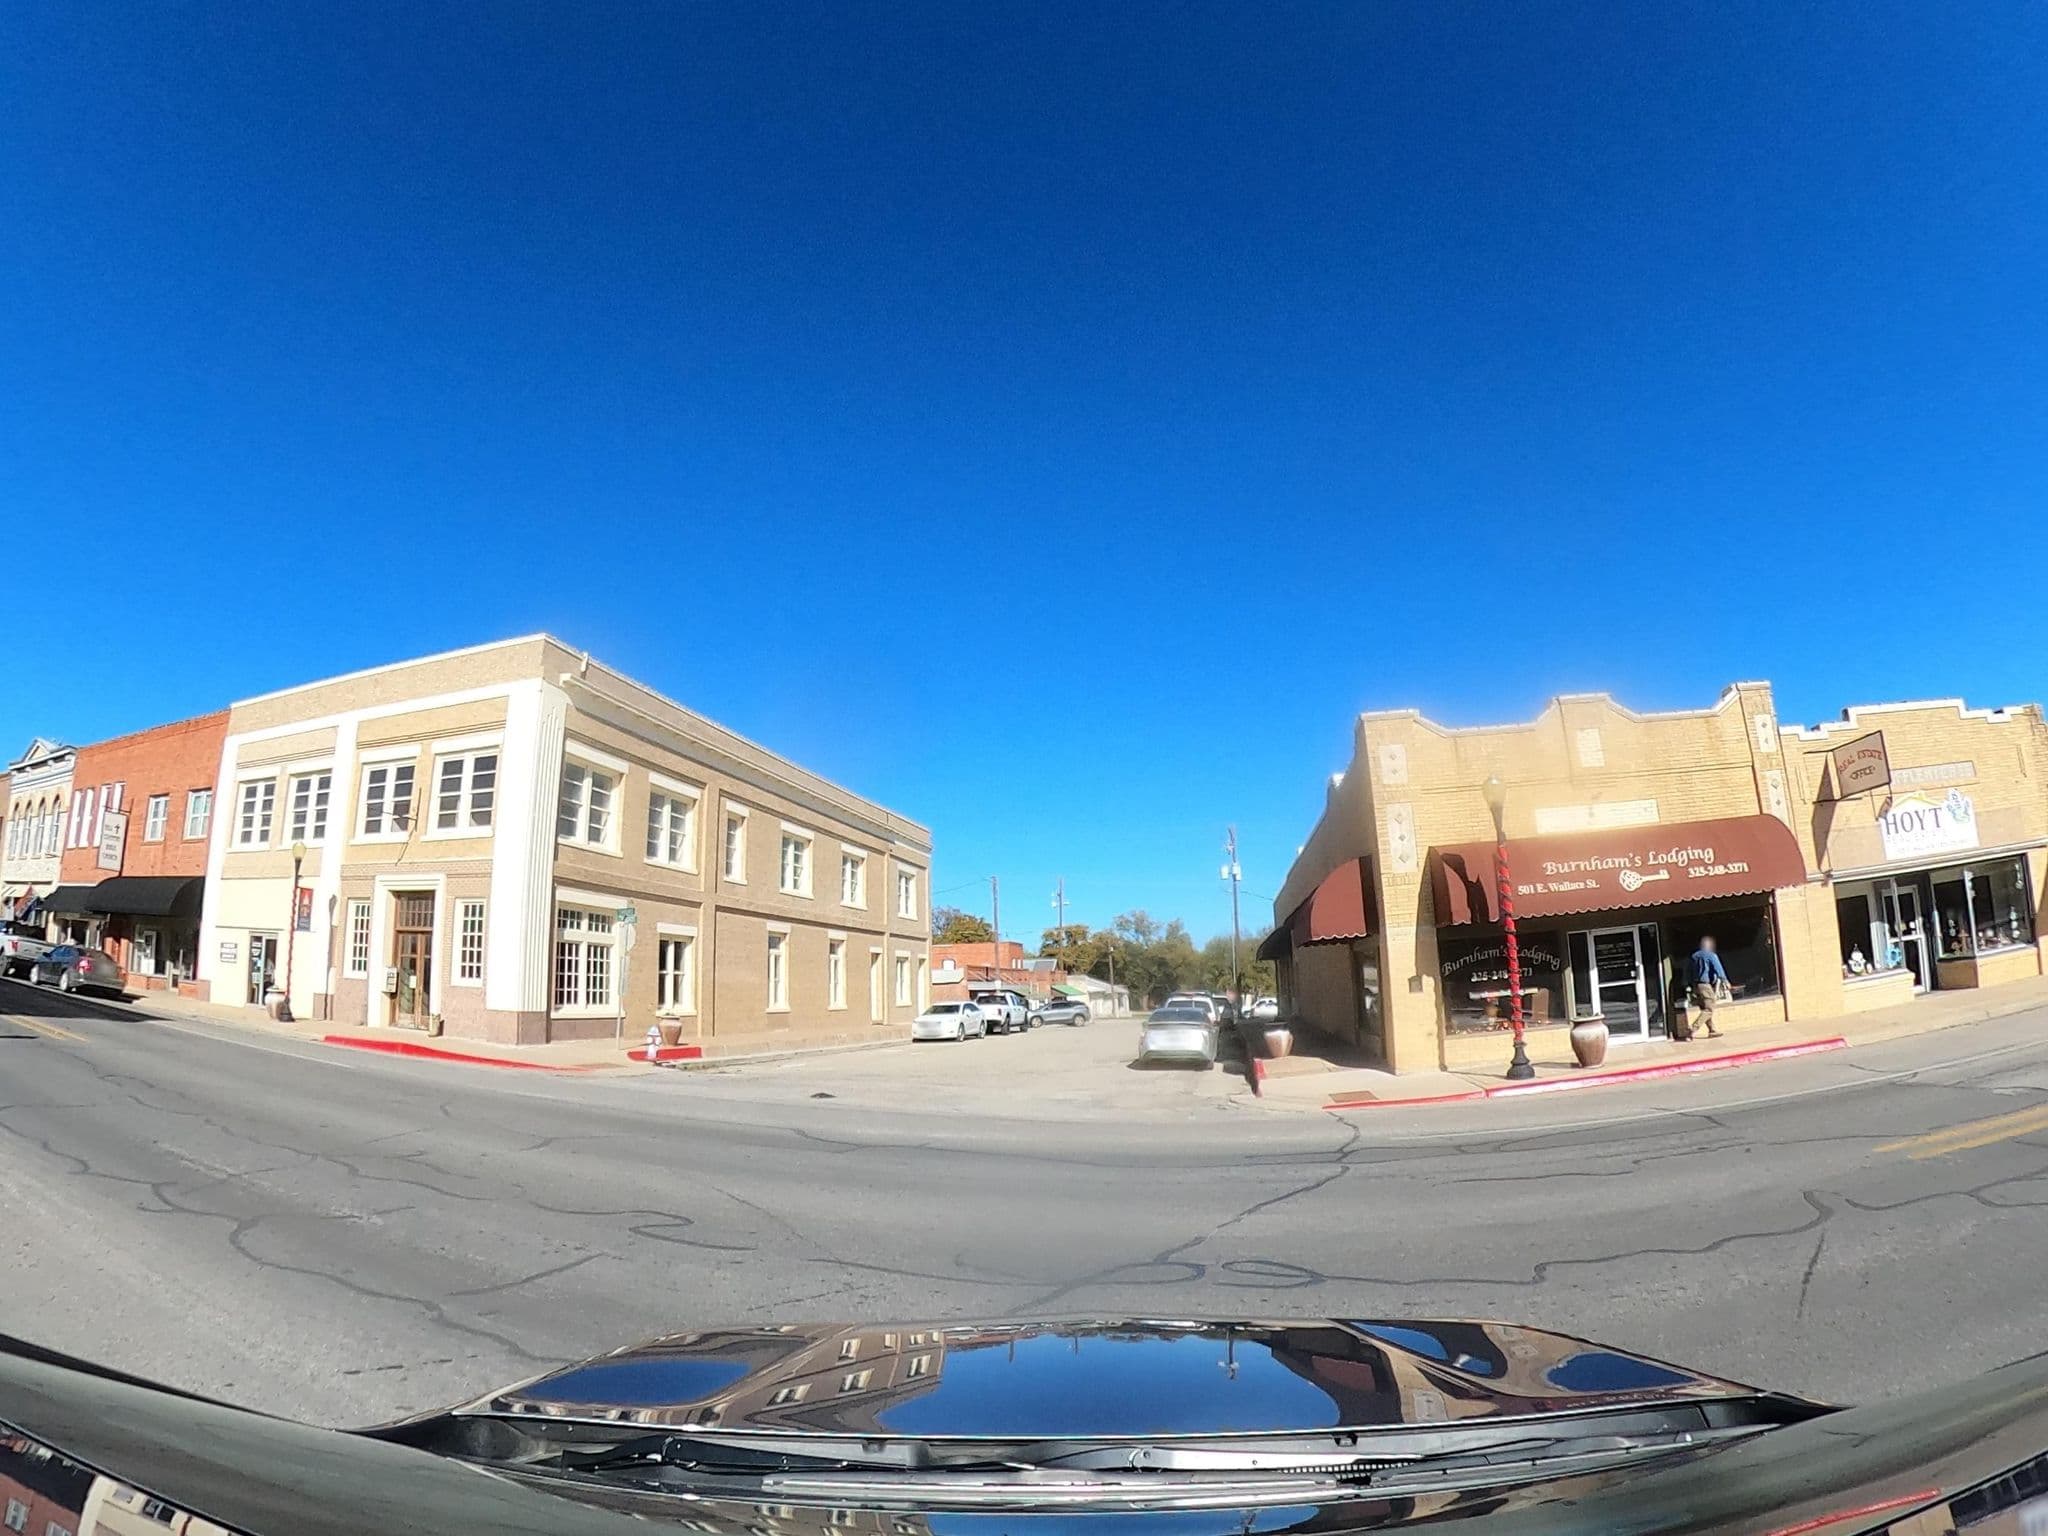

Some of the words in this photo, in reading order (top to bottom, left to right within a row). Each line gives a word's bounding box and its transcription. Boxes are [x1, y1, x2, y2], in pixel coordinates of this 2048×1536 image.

[1883, 807, 1942, 835] HOYT
[1542, 853, 1642, 875] Burnham's
[1647, 847, 1714, 867] Lodging
[1517, 884, 1535, 895] 501
[1536, 883, 1548, 893] E.
[1547, 881, 1585, 892] Wallace
